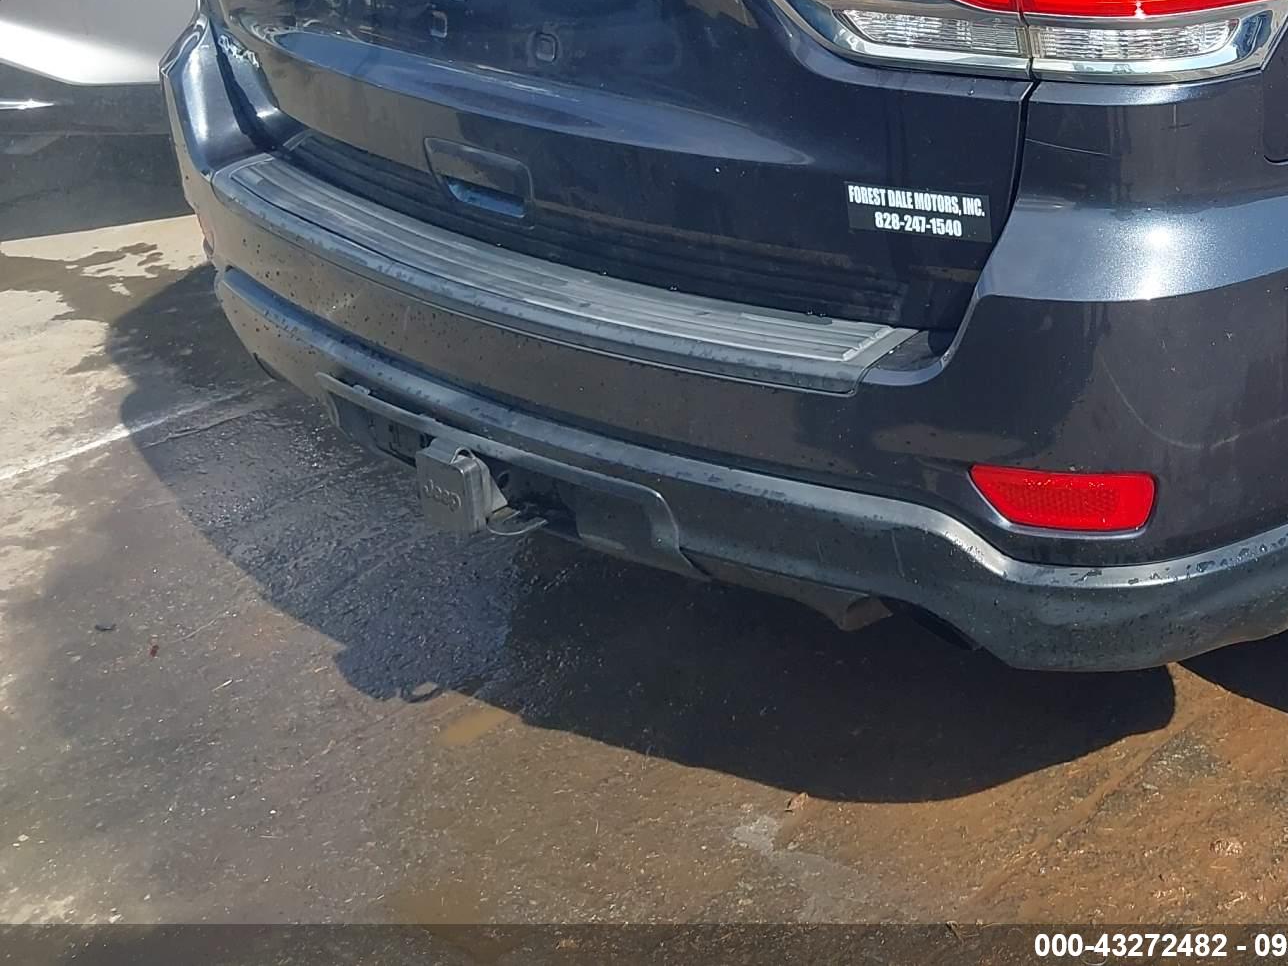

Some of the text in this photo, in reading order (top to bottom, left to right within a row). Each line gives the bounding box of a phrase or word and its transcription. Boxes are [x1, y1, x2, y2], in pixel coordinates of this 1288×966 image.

[848, 184, 985, 217] FOREST DALE MOTORS, INC.
[874, 211, 963, 237] 828-247-1540
[423, 479, 462, 514] Jeep
